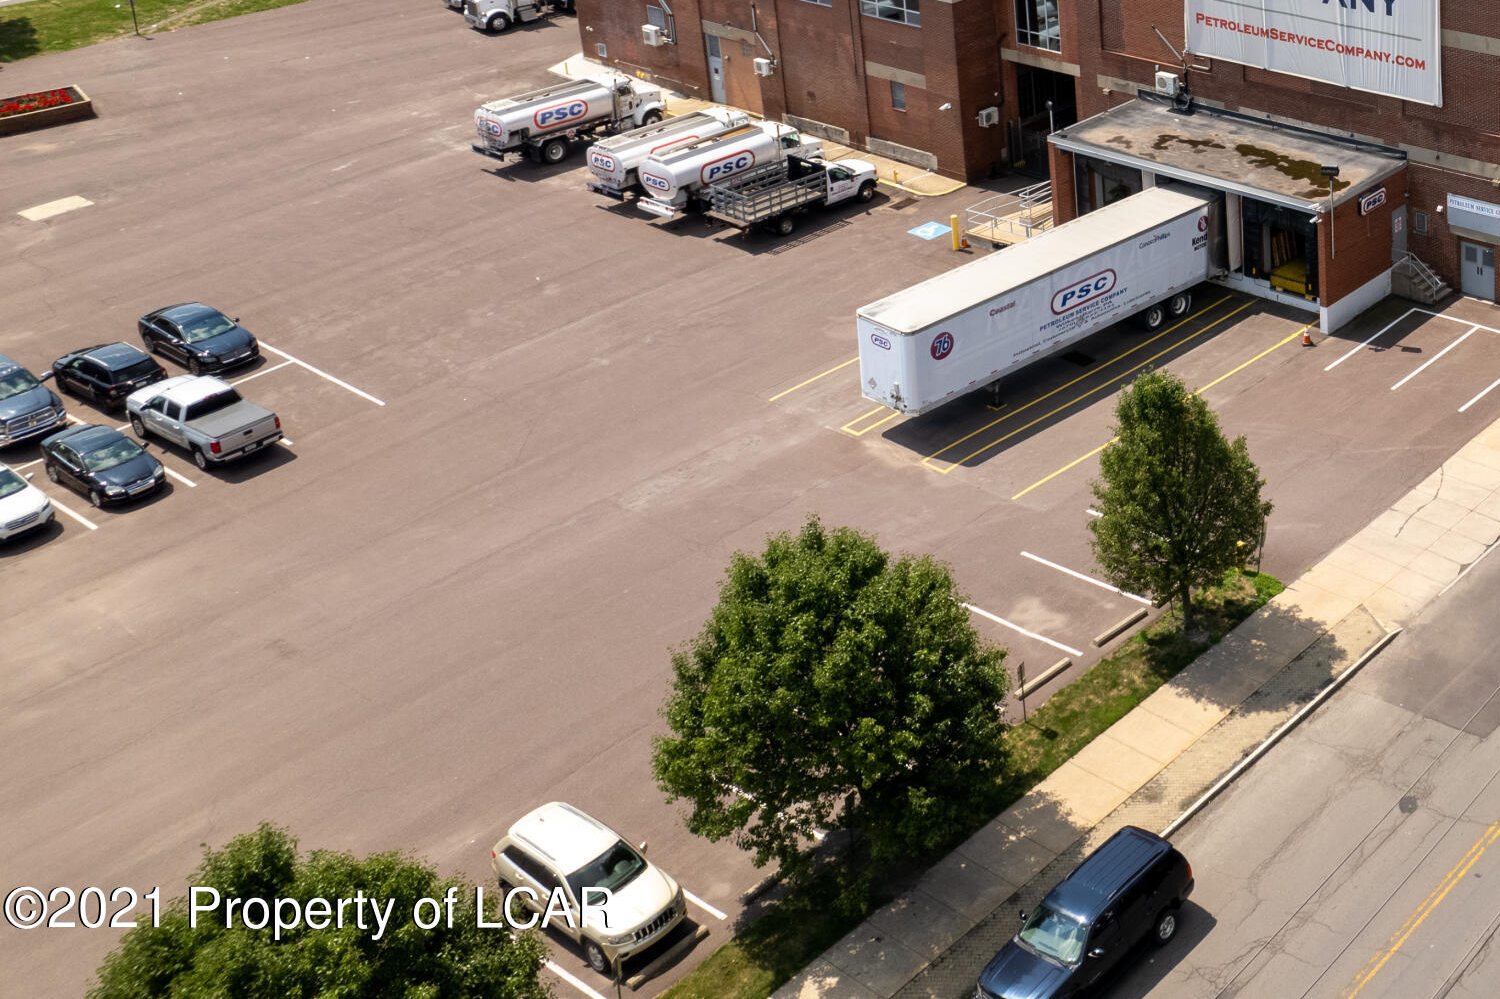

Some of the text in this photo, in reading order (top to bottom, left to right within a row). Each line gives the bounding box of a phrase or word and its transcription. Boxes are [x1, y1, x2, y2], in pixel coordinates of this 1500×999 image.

[540, 103, 582, 125] PSC
[594, 157, 612, 168] PSC
[709, 156, 748, 179] PSC
[646, 176, 666, 188] PSC
[1366, 194, 1384, 210] PSC
[1061, 277, 1107, 308] PSC
[989, 300, 1016, 317] Coastal
[1040, 287, 1128, 332] PETROLEUM SERVICE COMPANY
[874, 337, 888, 347] PSC
[936, 336, 949, 355] 76
